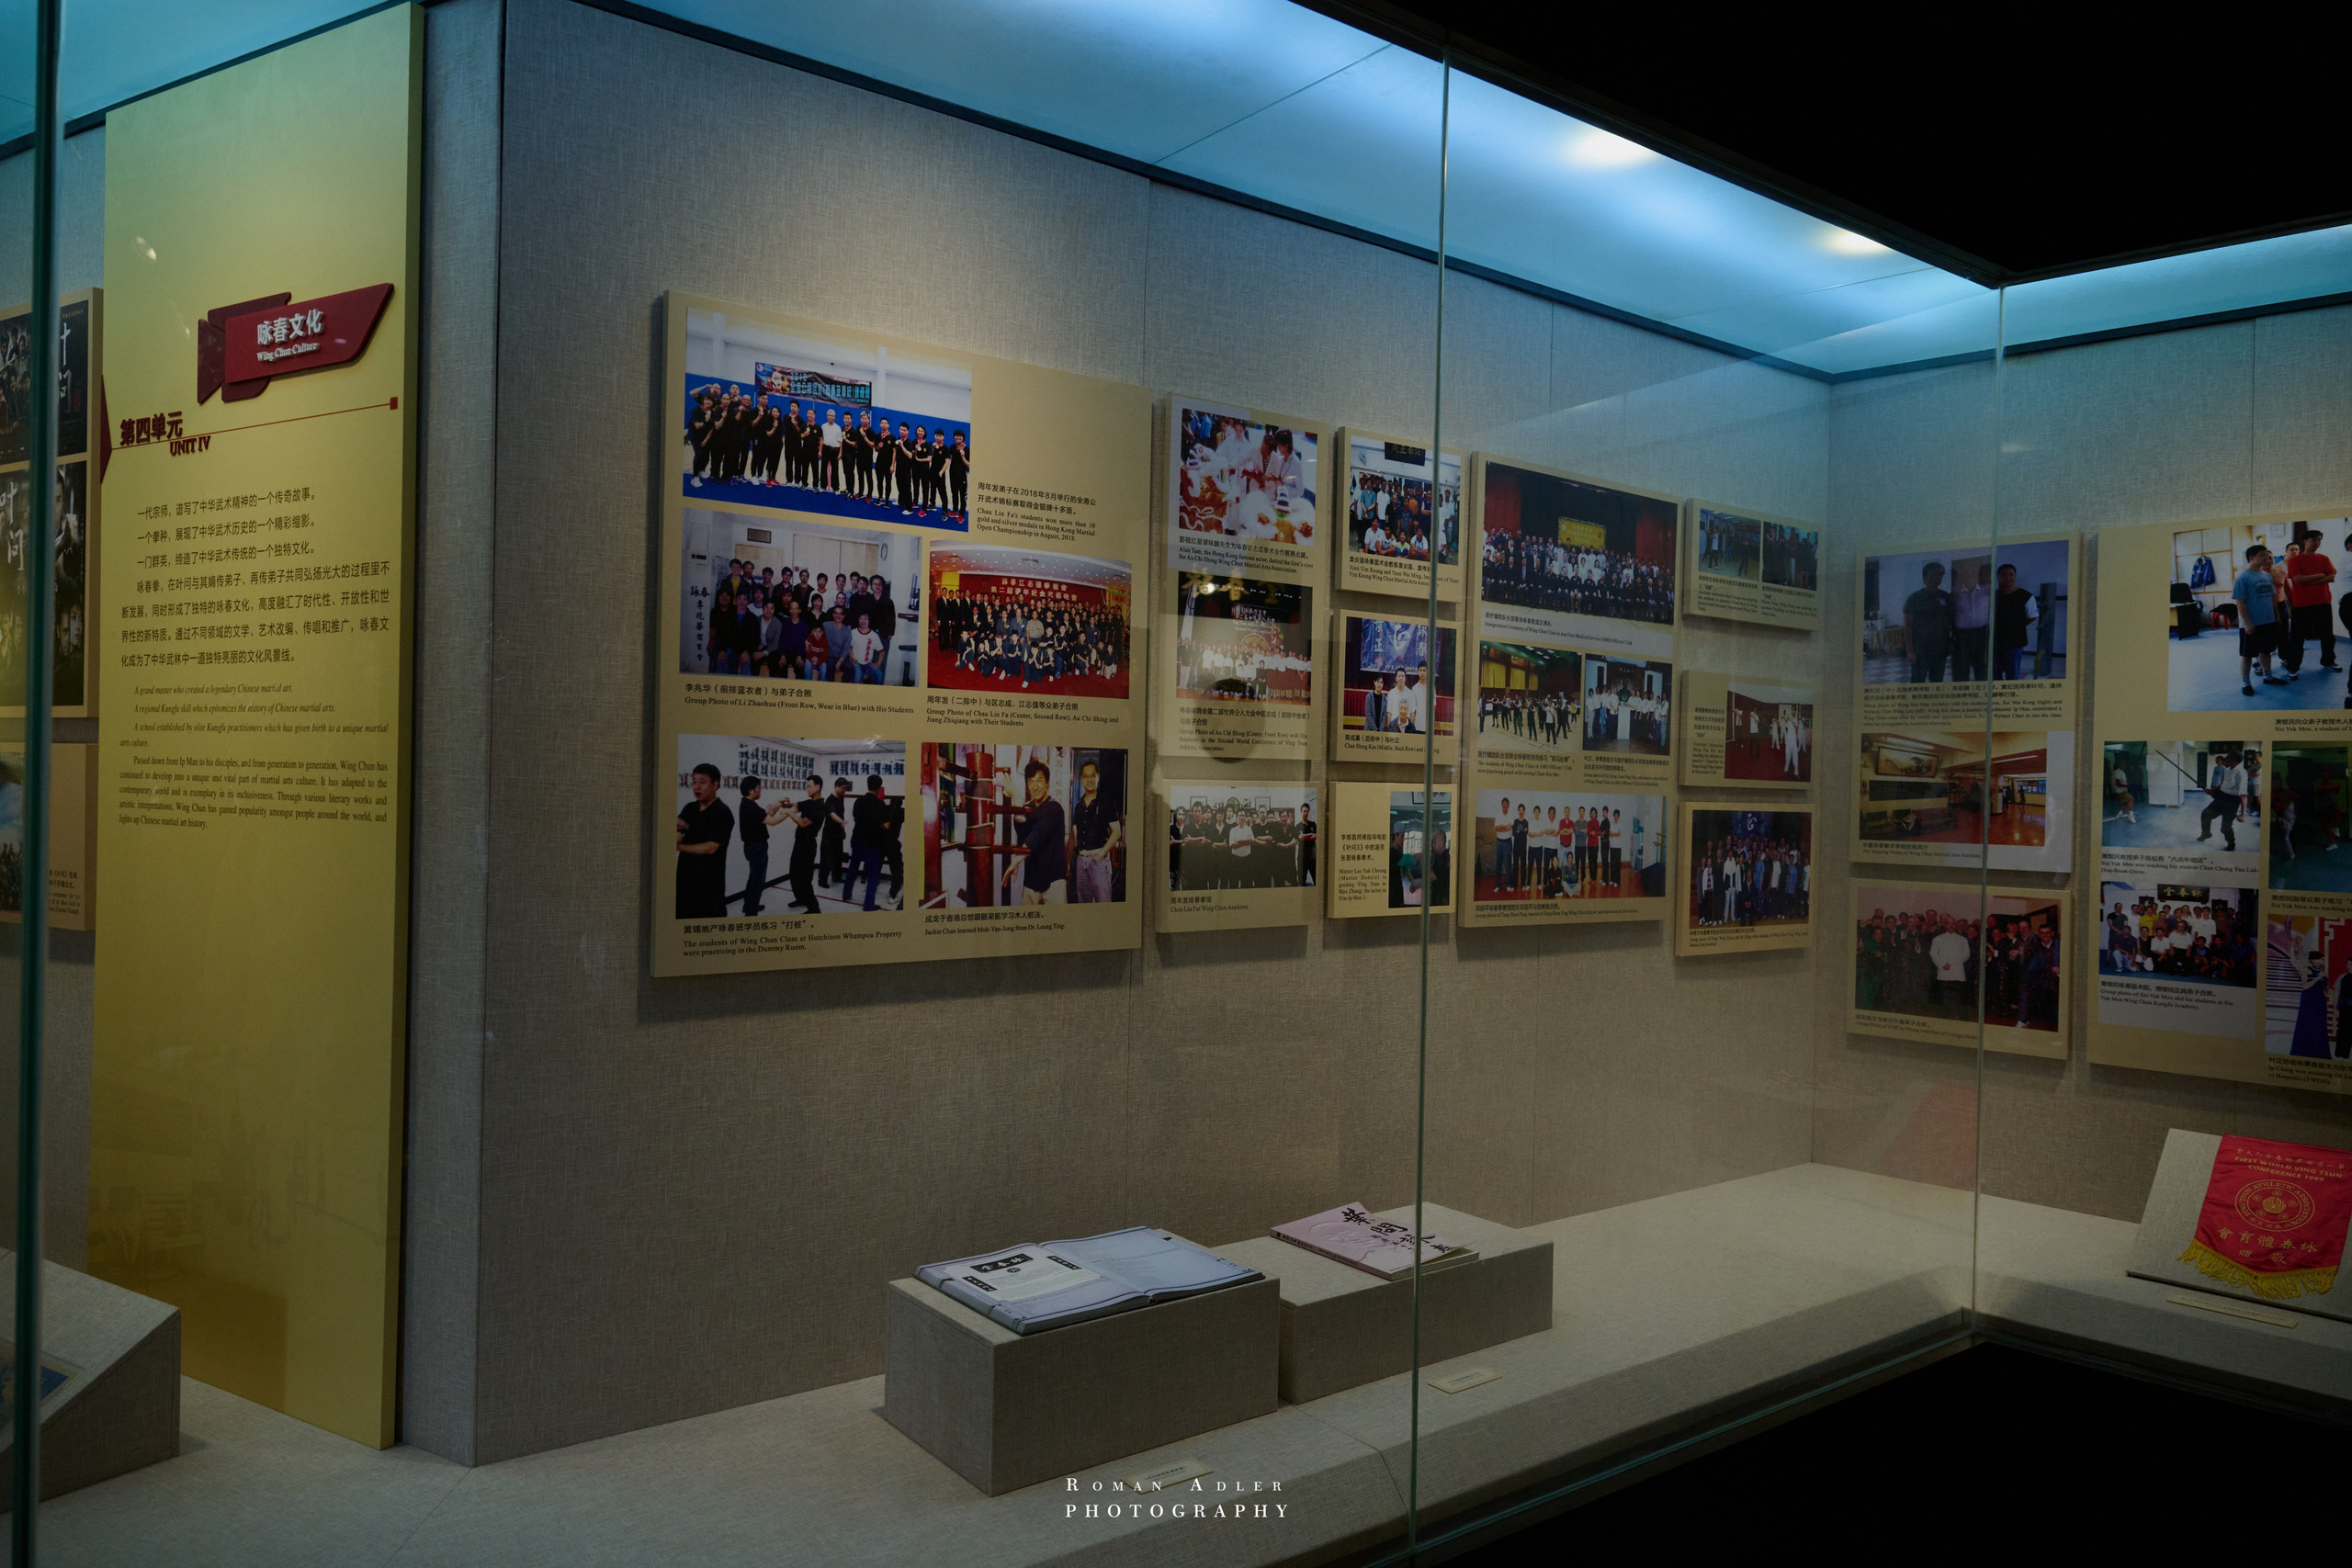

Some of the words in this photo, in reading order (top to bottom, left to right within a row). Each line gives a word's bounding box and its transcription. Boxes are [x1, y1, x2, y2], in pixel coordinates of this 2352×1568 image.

[257, 309, 324, 345] 咏春文化
[256, 351, 274, 363] Wing
[275, 347, 292, 358] Chun
[292, 342, 319, 354] Culture
[119, 412, 183, 446] 第四单元
[170, 438, 197, 456] UNIT
[198, 435, 211, 452] IV
[978, 482, 1096, 505] 周年发弟子在2018年8月举行的全港公
[138, 487, 315, 519] 一代宗师，谱写了中华武术精神的一个传奇故事。
[978, 495, 1076, 514] 开武术锦标赛取得金银牌十多面。
[138, 514, 315, 544] 一个拳种，展现了中华武术历史的一个精彩缩影。
[978, 516, 990, 525] gold
[990, 518, 1001, 527] and
[1019, 522, 1038, 530] medals
[1046, 525, 1060, 533] Hong
[1061, 526, 1076, 535] Kong
[1077, 528, 1095, 536] Martial
[993, 525, 1034, 537] Championship
[1040, 532, 1061, 540] August,
[137, 540, 314, 568] 一门群英，缔造了中华武术传统的一个独特文化。
[1204, 557, 1218, 565] Shing
[1218, 558, 1231, 567] Wing
[121, 649, 295, 667] 化成为了中华武林中一道独特亮丽的文化风景线。
[685, 683, 812, 697] 李兆华（前排蓝衣者）与弟子合照
[134, 705, 139, 713] A
[140, 705, 161, 715] regional
[180, 704, 192, 713] skill
[193, 704, 209, 713] which
[209, 704, 237, 715] epitomizes
[238, 704, 247, 713] the
[247, 705, 267, 715] history
[268, 704, 276, 715] of
[275, 704, 299, 713] Chinese
[300, 704, 322, 712] martial
[684, 696, 707, 705] Group
[842, 704, 861, 712] Blue)
[927, 696, 1079, 710] 周年发（二排中）与区志成、江志强等众弟子合照
[927, 708, 946, 718] Group
[946, 709, 965, 718] Photo
[974, 710, 989, 720] Chau
[990, 711, 1000, 720] Lin
[1001, 712, 1009, 720] Fa
[1010, 712, 1033, 721] (Center,
[1093, 716, 1108, 724] Shing
[944, 716, 969, 726] Zhiqiang
[925, 911, 1045, 922] 成龙于香港总馆跟随梁挺学习木人桩法。
[684, 920, 814, 933] 黄埔地产咏春班学员练习“打桩”。
[760, 937, 778, 946] Chun
[780, 936, 798, 945] Class
[702, 948, 737, 957] practicing
[2248, 1165, 2301, 1179] CONFERENCE
[2260, 1161, 2292, 1169] WORLD
[2253, 1181, 2295, 1190] ATHLETIC
[2292, 1189, 2311, 1226] ASSOCIATION
